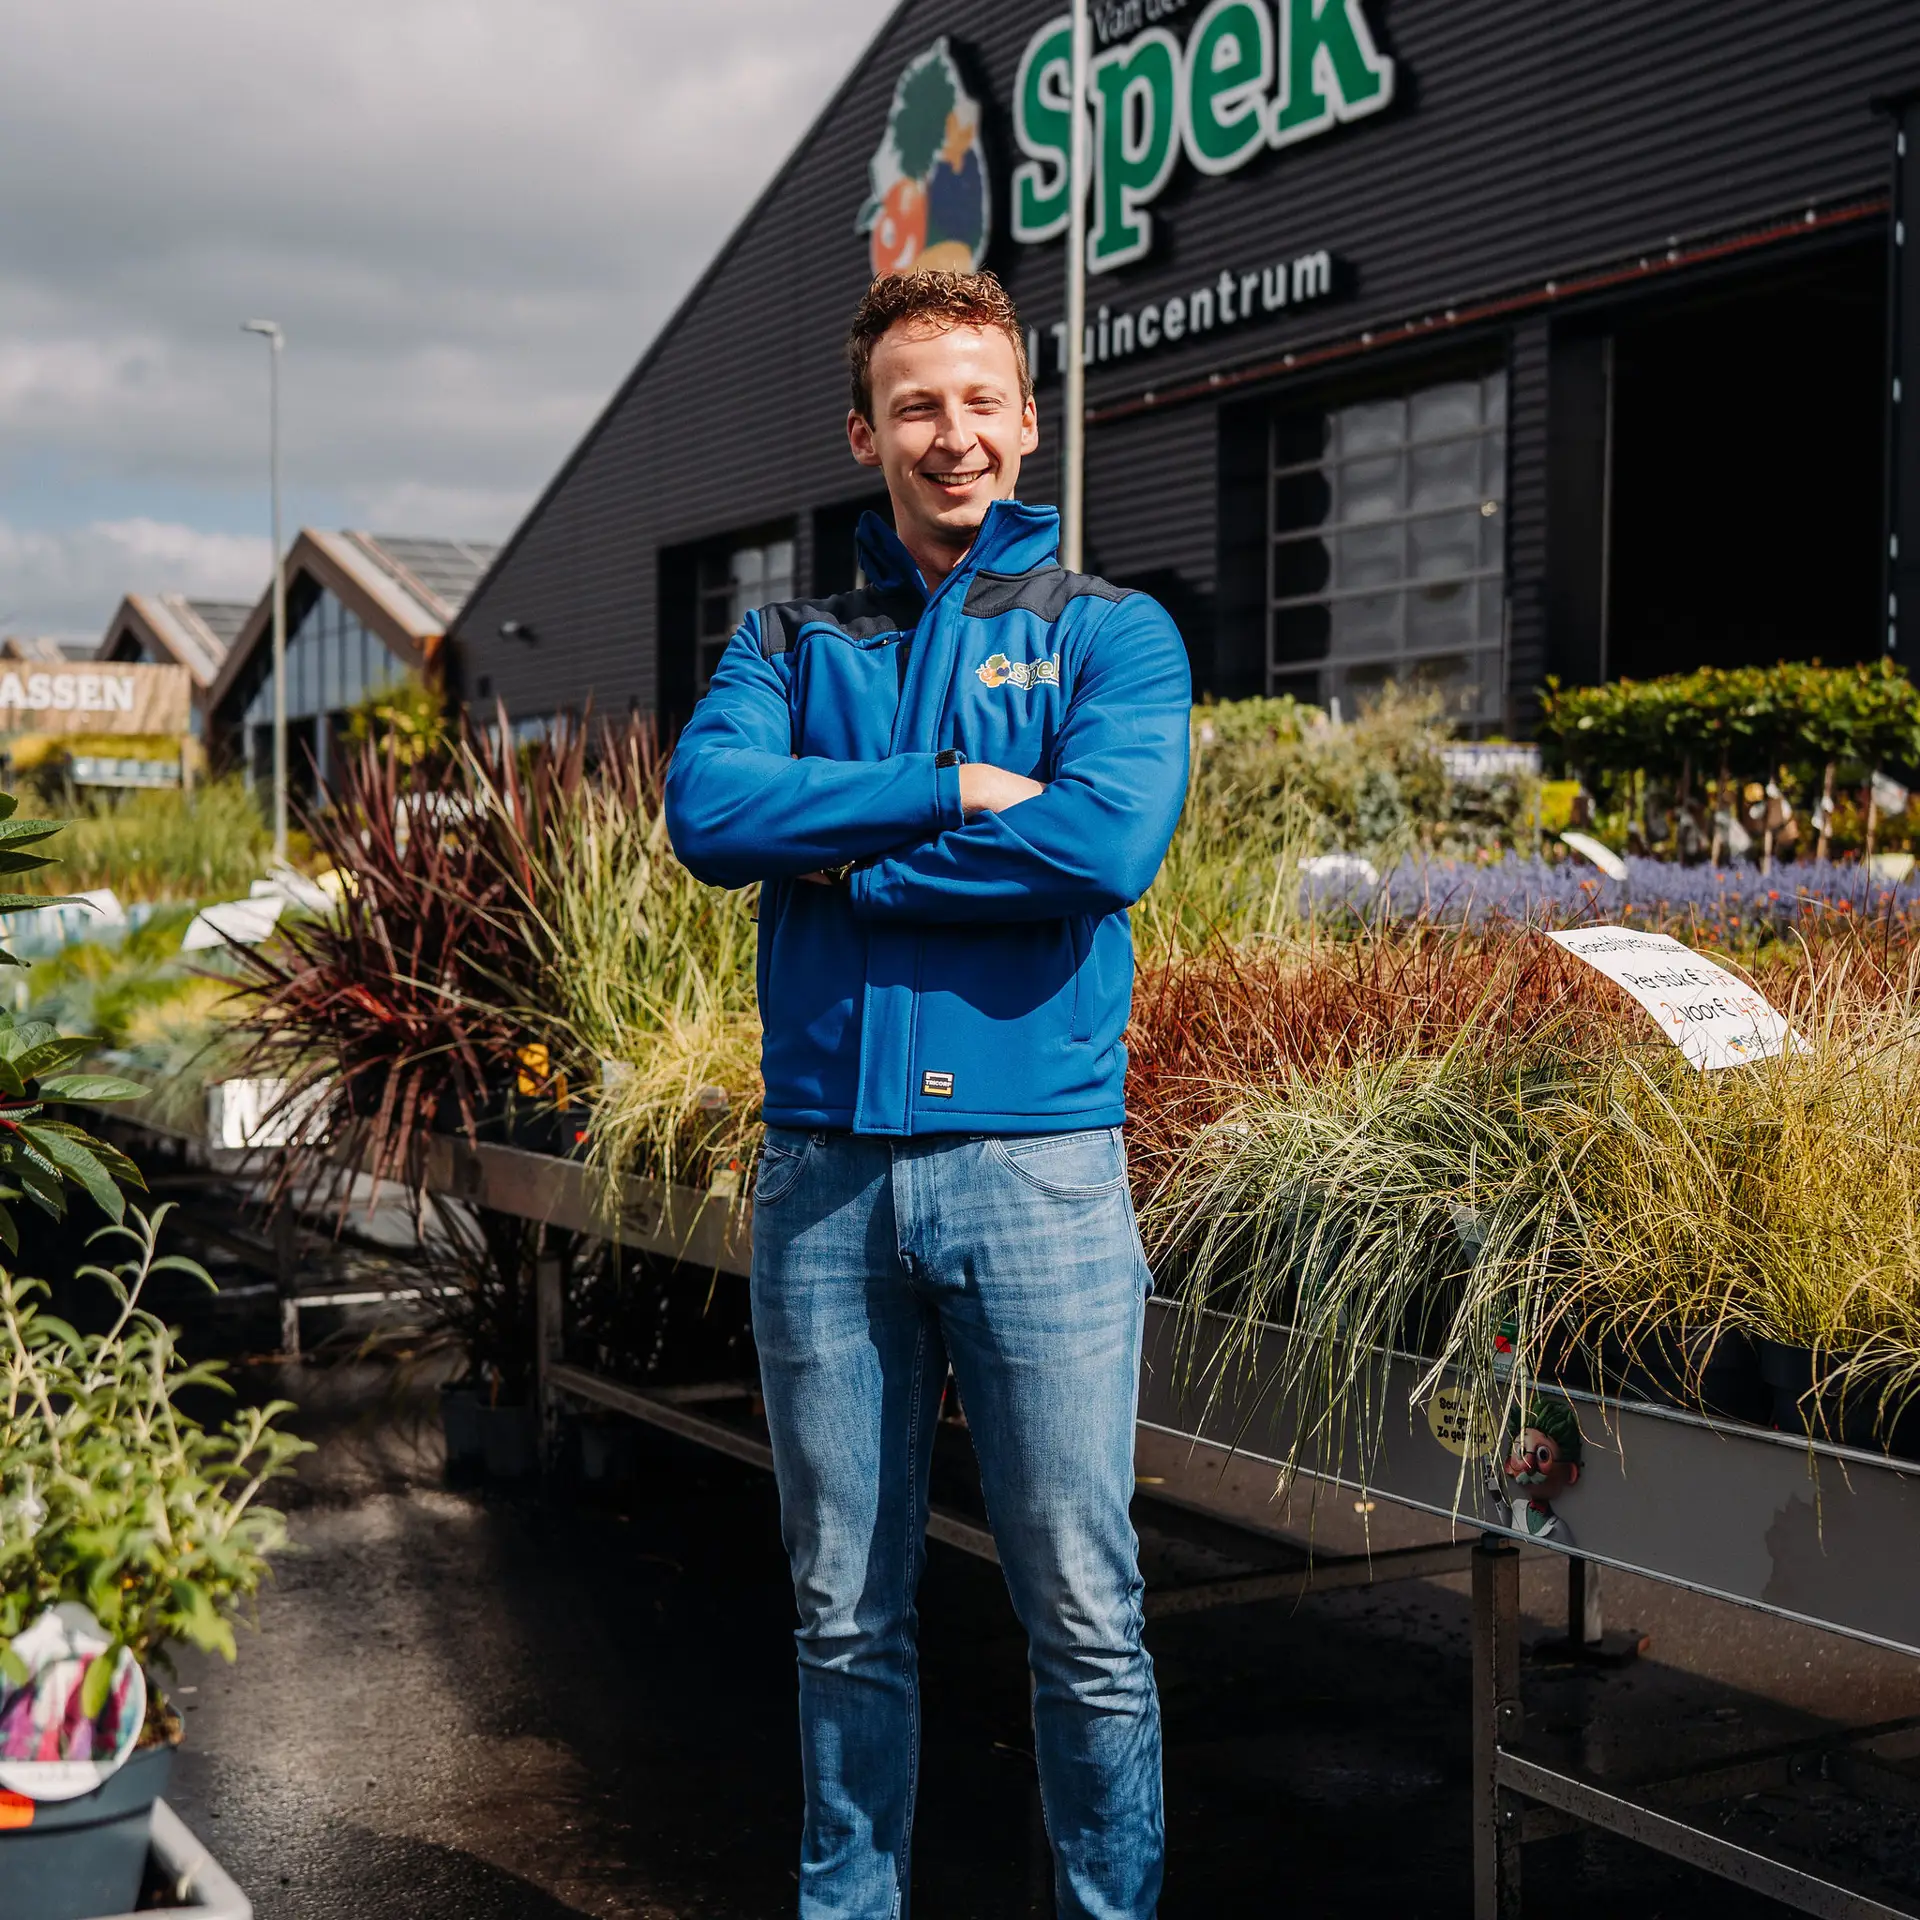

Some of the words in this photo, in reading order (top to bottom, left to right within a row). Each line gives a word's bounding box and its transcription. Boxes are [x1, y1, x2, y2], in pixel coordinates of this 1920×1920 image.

[1012, 0, 1393, 273] Spek
[1621, 971, 1659, 989] Per
[1654, 966, 1695, 987] stuk
[1660, 1001, 1684, 1025] 2
[1677, 1002, 1720, 1023] voor
[925, 1079, 952, 1087] TRICORP
[1437, 1425, 1449, 1439] Zo
